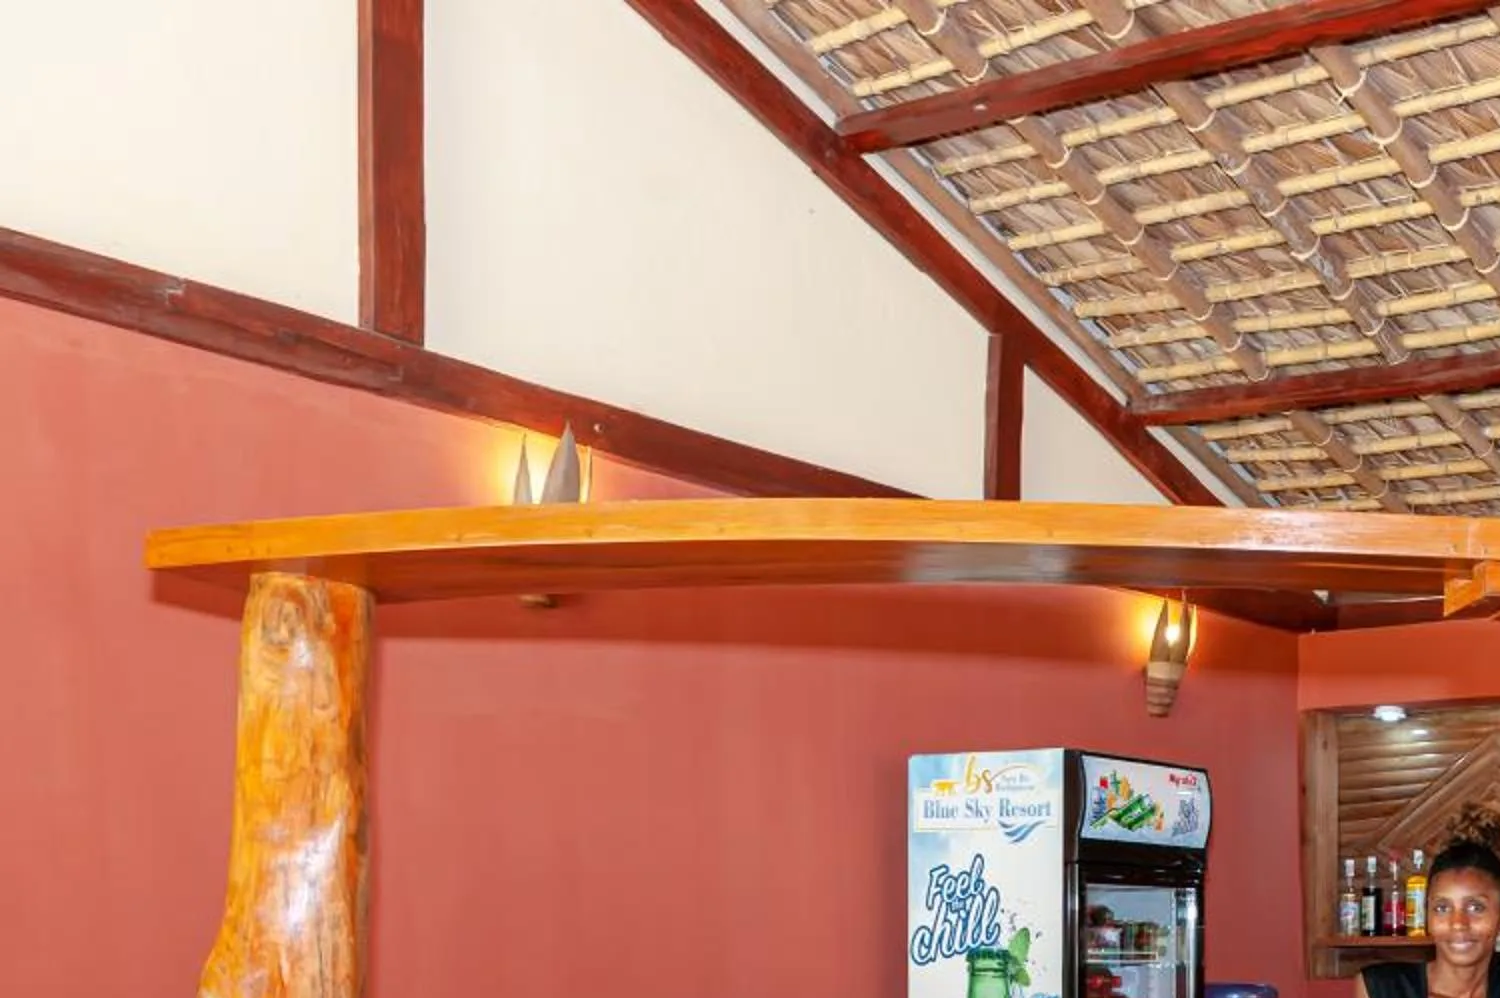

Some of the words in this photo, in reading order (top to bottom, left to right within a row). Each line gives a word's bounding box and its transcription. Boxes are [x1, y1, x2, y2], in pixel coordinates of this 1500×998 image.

[923, 799, 958, 819] Blue
[965, 797, 993, 823] Sky
[999, 798, 1052, 818] Resort
[926, 853, 985, 911] Feel
[911, 885, 1000, 967] chill
